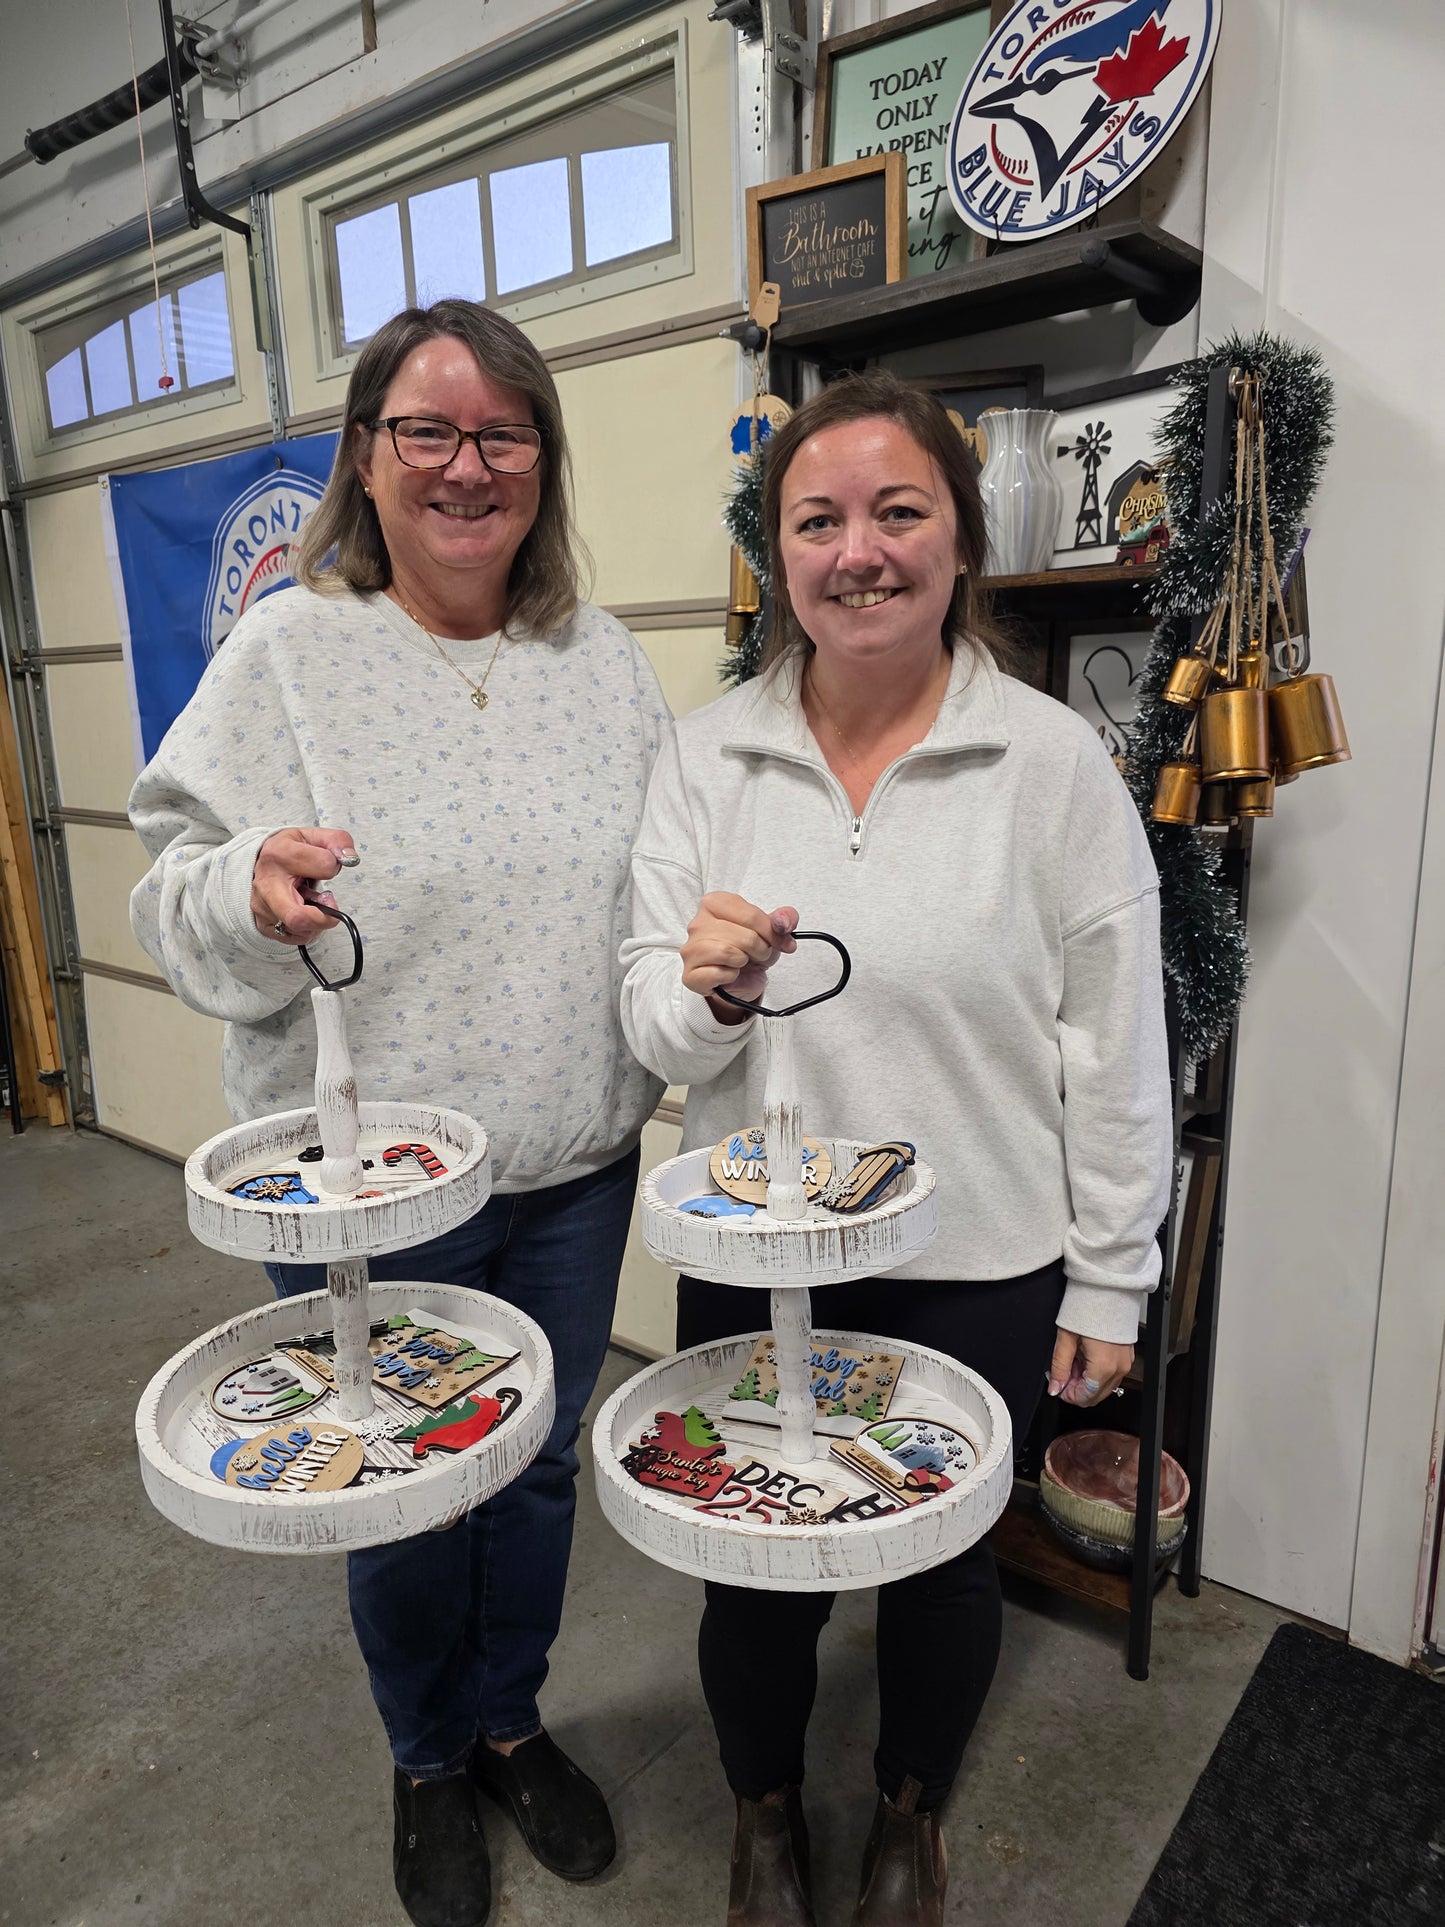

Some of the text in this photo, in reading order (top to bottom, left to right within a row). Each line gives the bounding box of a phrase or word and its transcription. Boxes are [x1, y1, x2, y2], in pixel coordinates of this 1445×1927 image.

[869, 57, 948, 100] TODAY
[876, 93, 938, 130] ONLY
[906, 161, 932, 187] CE
[957, 110, 1161, 228] BLUE JAYS
[789, 200, 827, 225] THIS IS A
[773, 219, 879, 265] Bathroom
[791, 240, 875, 273] NOT AN INTERNET CAFE
[1118, 492, 1168, 521] CHRISTM
[218, 498, 312, 617] TORONT
[728, 1135, 820, 1165] heo
[721, 1159, 818, 1185] WINR
[809, 1348, 864, 1380] aby
[236, 1426, 313, 1491] hello
[273, 1431, 350, 1495] WINTER
[658, 1449, 722, 1476] Santa's
[683, 1471, 710, 1493] key
[731, 1460, 825, 1508] DEC
[693, 1485, 791, 1525] 25
